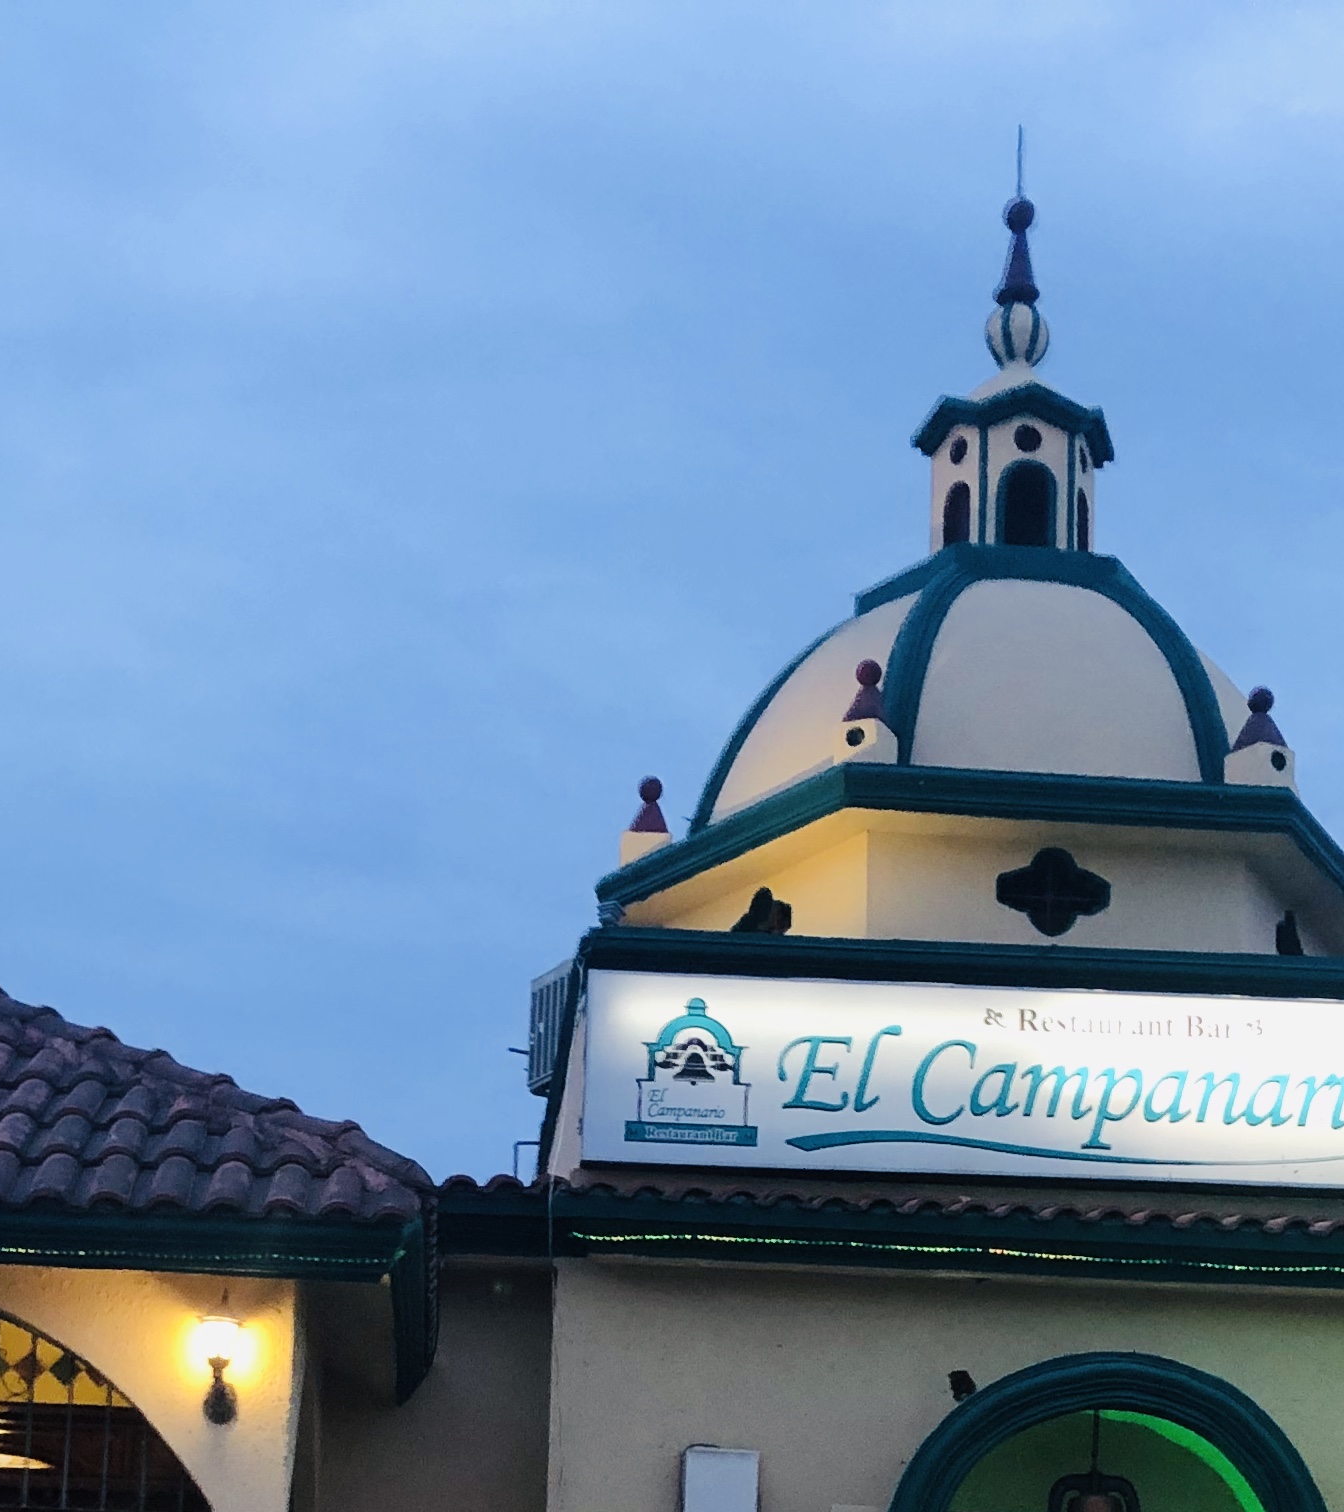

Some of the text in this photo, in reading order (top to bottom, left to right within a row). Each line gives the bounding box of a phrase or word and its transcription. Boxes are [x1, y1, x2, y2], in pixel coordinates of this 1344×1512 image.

[1017, 1008, 1231, 1039] Restaurant Bar
[778, 1025, 903, 1113] El
[647, 1087, 669, 1102] El
[647, 1103, 726, 1121] Campanario
